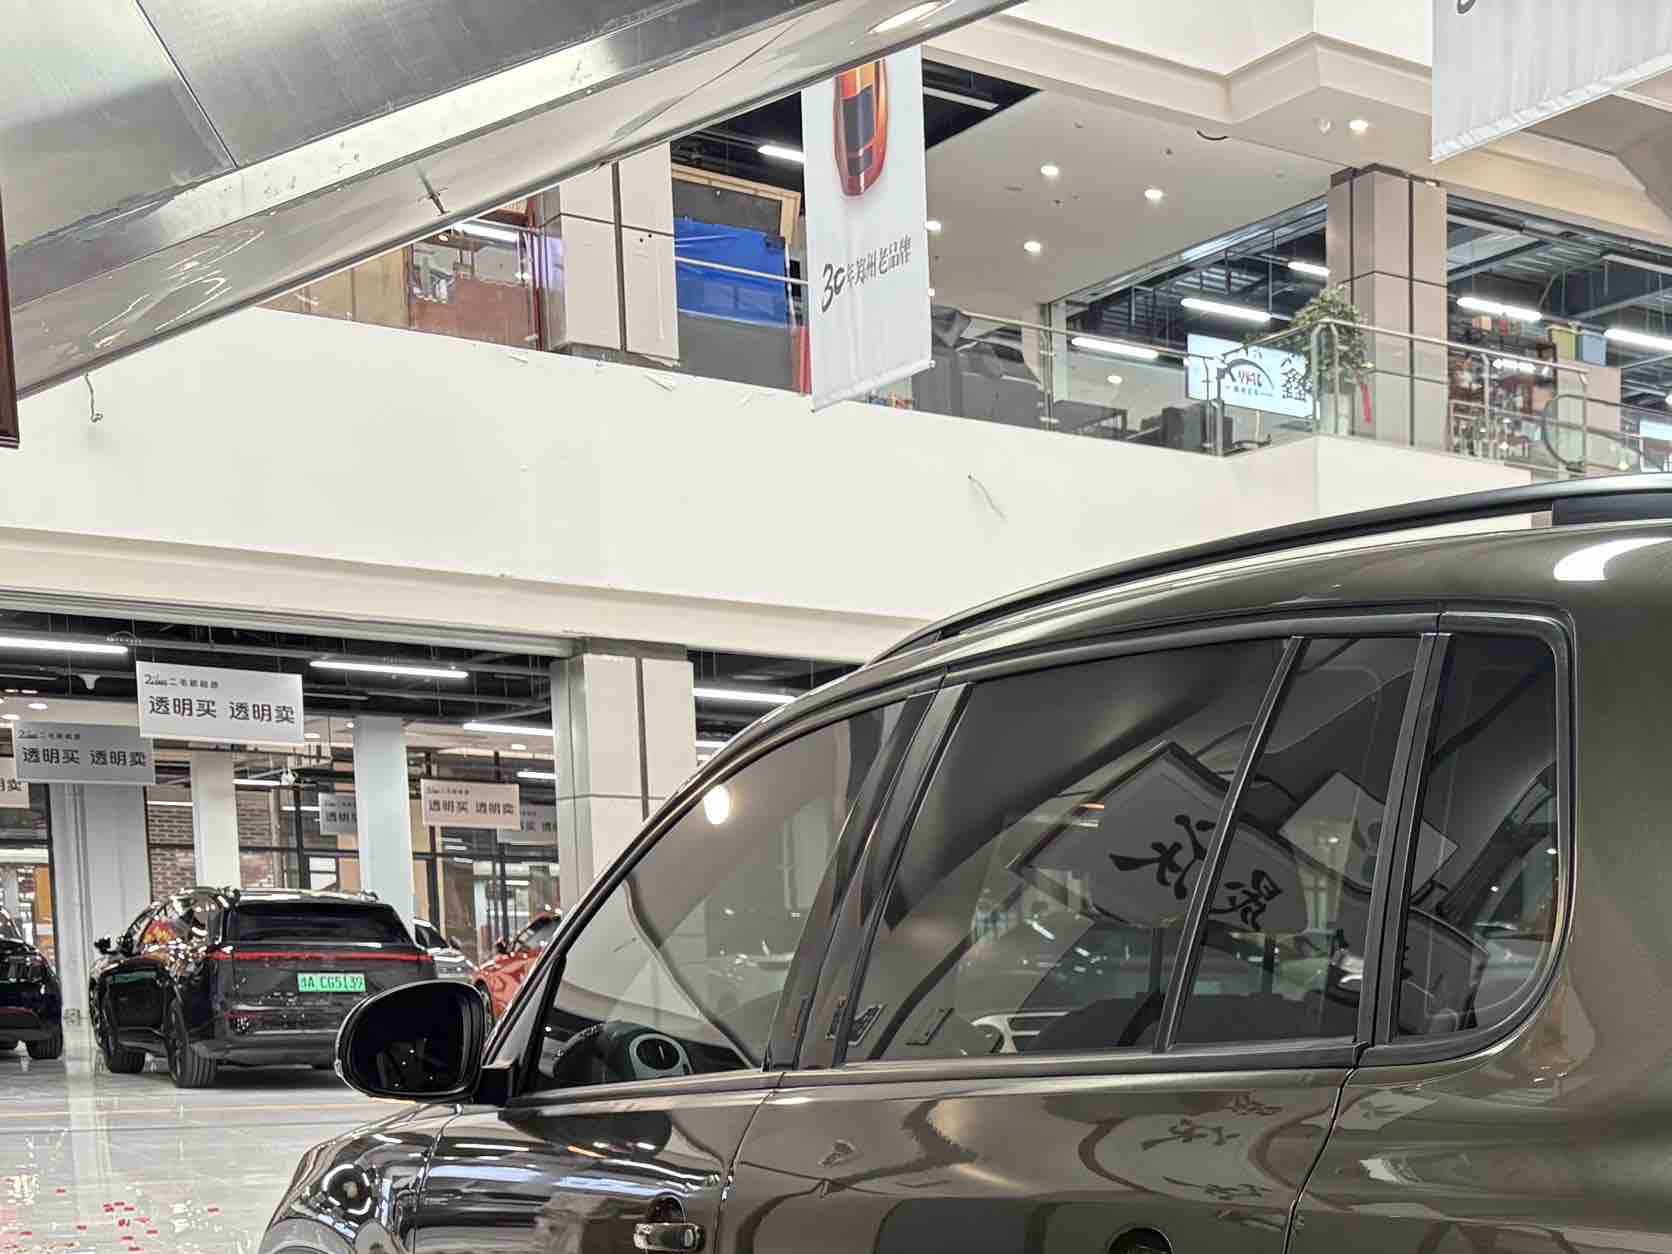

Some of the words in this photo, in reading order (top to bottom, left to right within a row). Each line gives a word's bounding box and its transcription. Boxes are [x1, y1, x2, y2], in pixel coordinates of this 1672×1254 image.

[149, 696, 217, 718] 透明买
[229, 701, 296, 724] 透明卖
[23, 747, 81, 765] 透明买
[90, 750, 147, 767] 透明卖
[428, 800, 469, 814] 透明买
[475, 803, 515, 816] 透明卖
